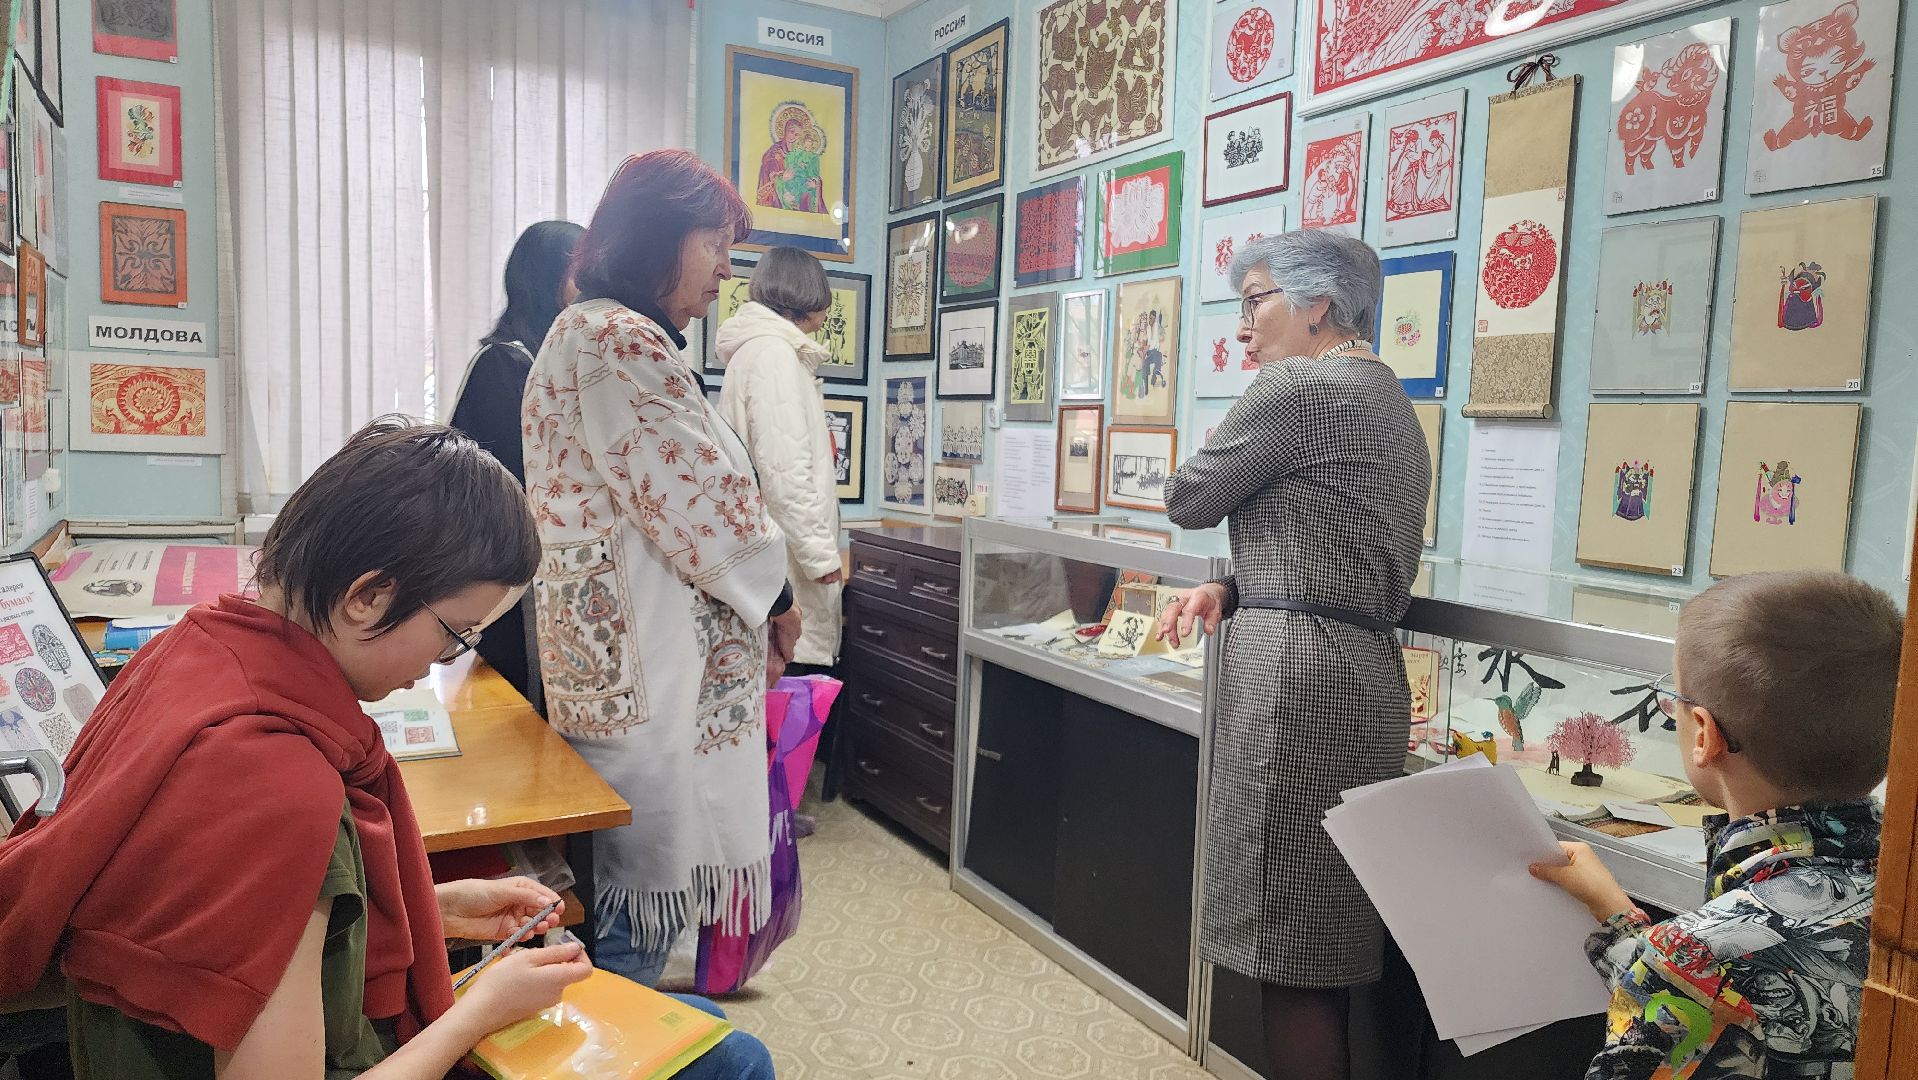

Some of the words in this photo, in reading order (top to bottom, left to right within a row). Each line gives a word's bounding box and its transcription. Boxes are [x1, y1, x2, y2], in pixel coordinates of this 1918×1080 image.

[767, 27, 825, 47] РОССИЯ
[934, 15, 966, 41] РОССИЯ
[1803, 94, 1838, 128] 福
[95, 325, 203, 343] МОЛДОВА
[1847, 381, 1859, 389] 20
[1672, 567, 1682, 575] 23
[0, 582, 24, 594] алерея
